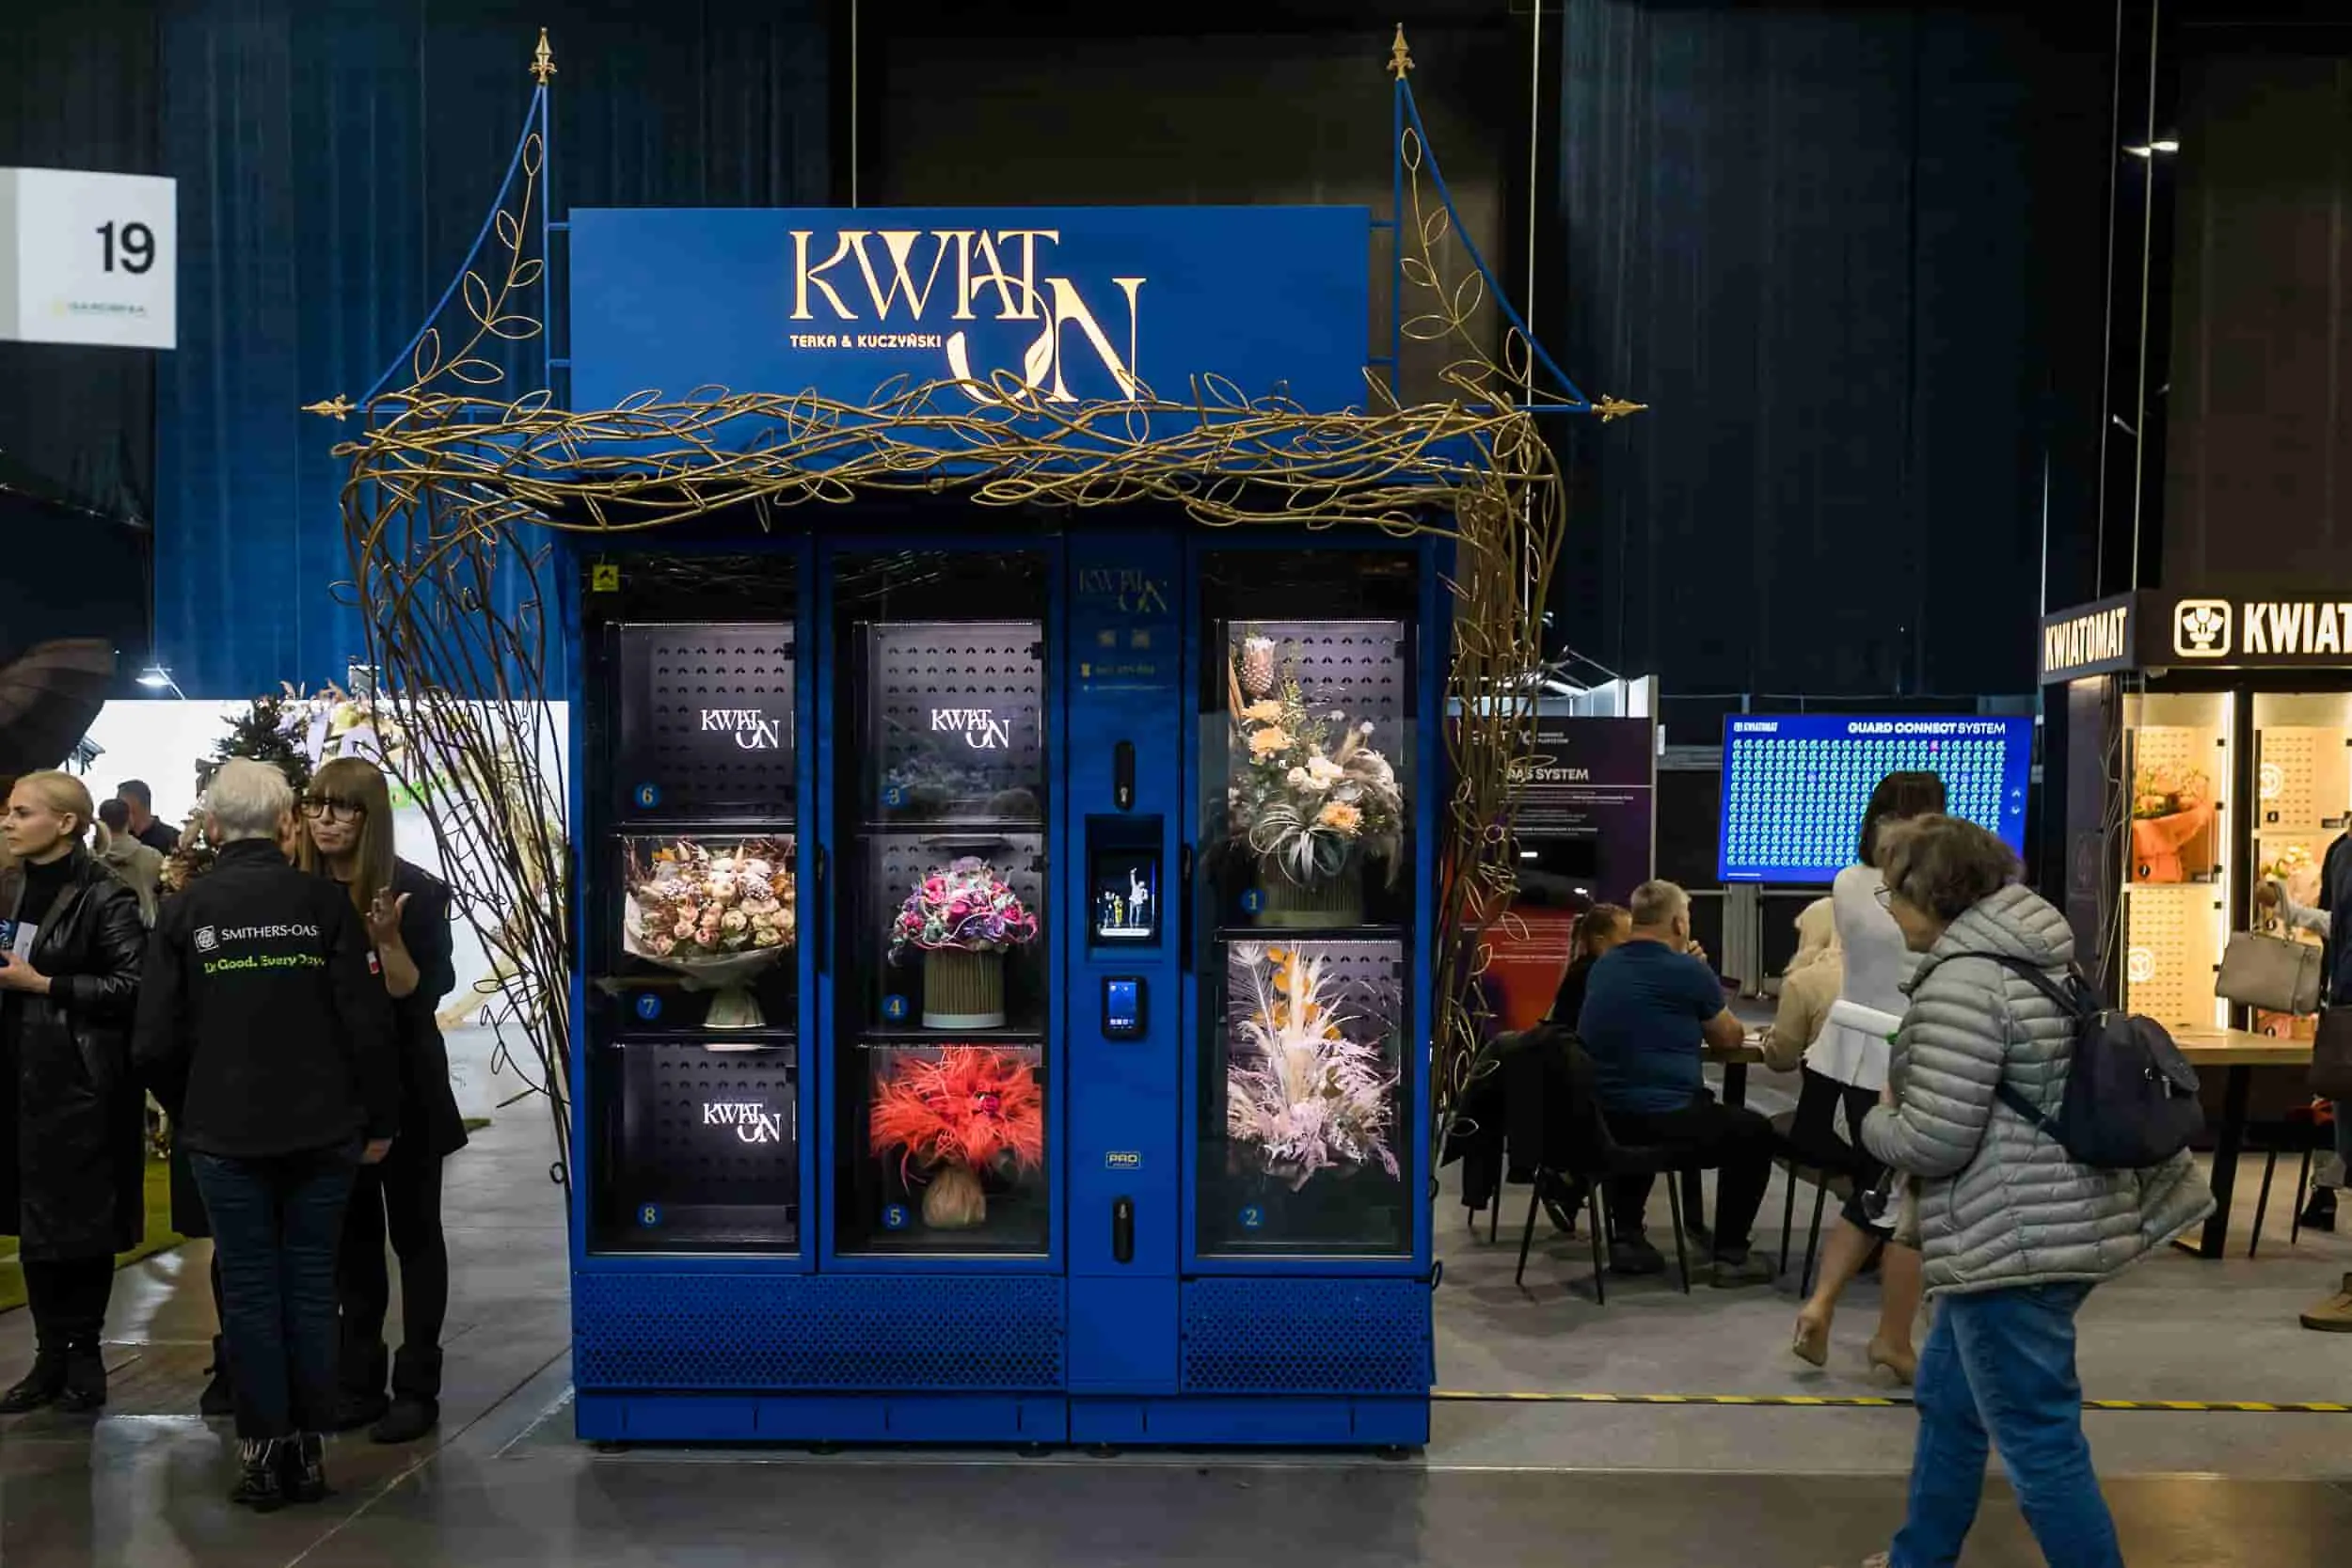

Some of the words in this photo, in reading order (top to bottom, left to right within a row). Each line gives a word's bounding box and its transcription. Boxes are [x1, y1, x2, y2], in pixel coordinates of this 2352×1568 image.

[95, 220, 156, 275] 19
[788, 229, 1059, 321] KWIAT
[789, 334, 837, 348] TERKA
[841, 334, 852, 348] &
[857, 332, 941, 348] KUCZYŃSKI
[2242, 602, 2352, 655] KWIAT
[2043, 606, 2128, 672] KWIATOMAT
[1895, 721, 1957, 735] CONNECT
[1958, 722, 2006, 735] SYSTEM
[1535, 768, 1589, 781] SYSTEM
[641, 787, 654, 804] 6
[887, 787, 900, 804] 3
[1248, 893, 1258, 911] 1
[217, 955, 258, 971] Good.
[643, 999, 655, 1015] 7
[887, 999, 901, 1015] 4
[644, 1207, 656, 1224] 8
[888, 1208, 901, 1225] 5
[1246, 1209, 1258, 1226] 2
